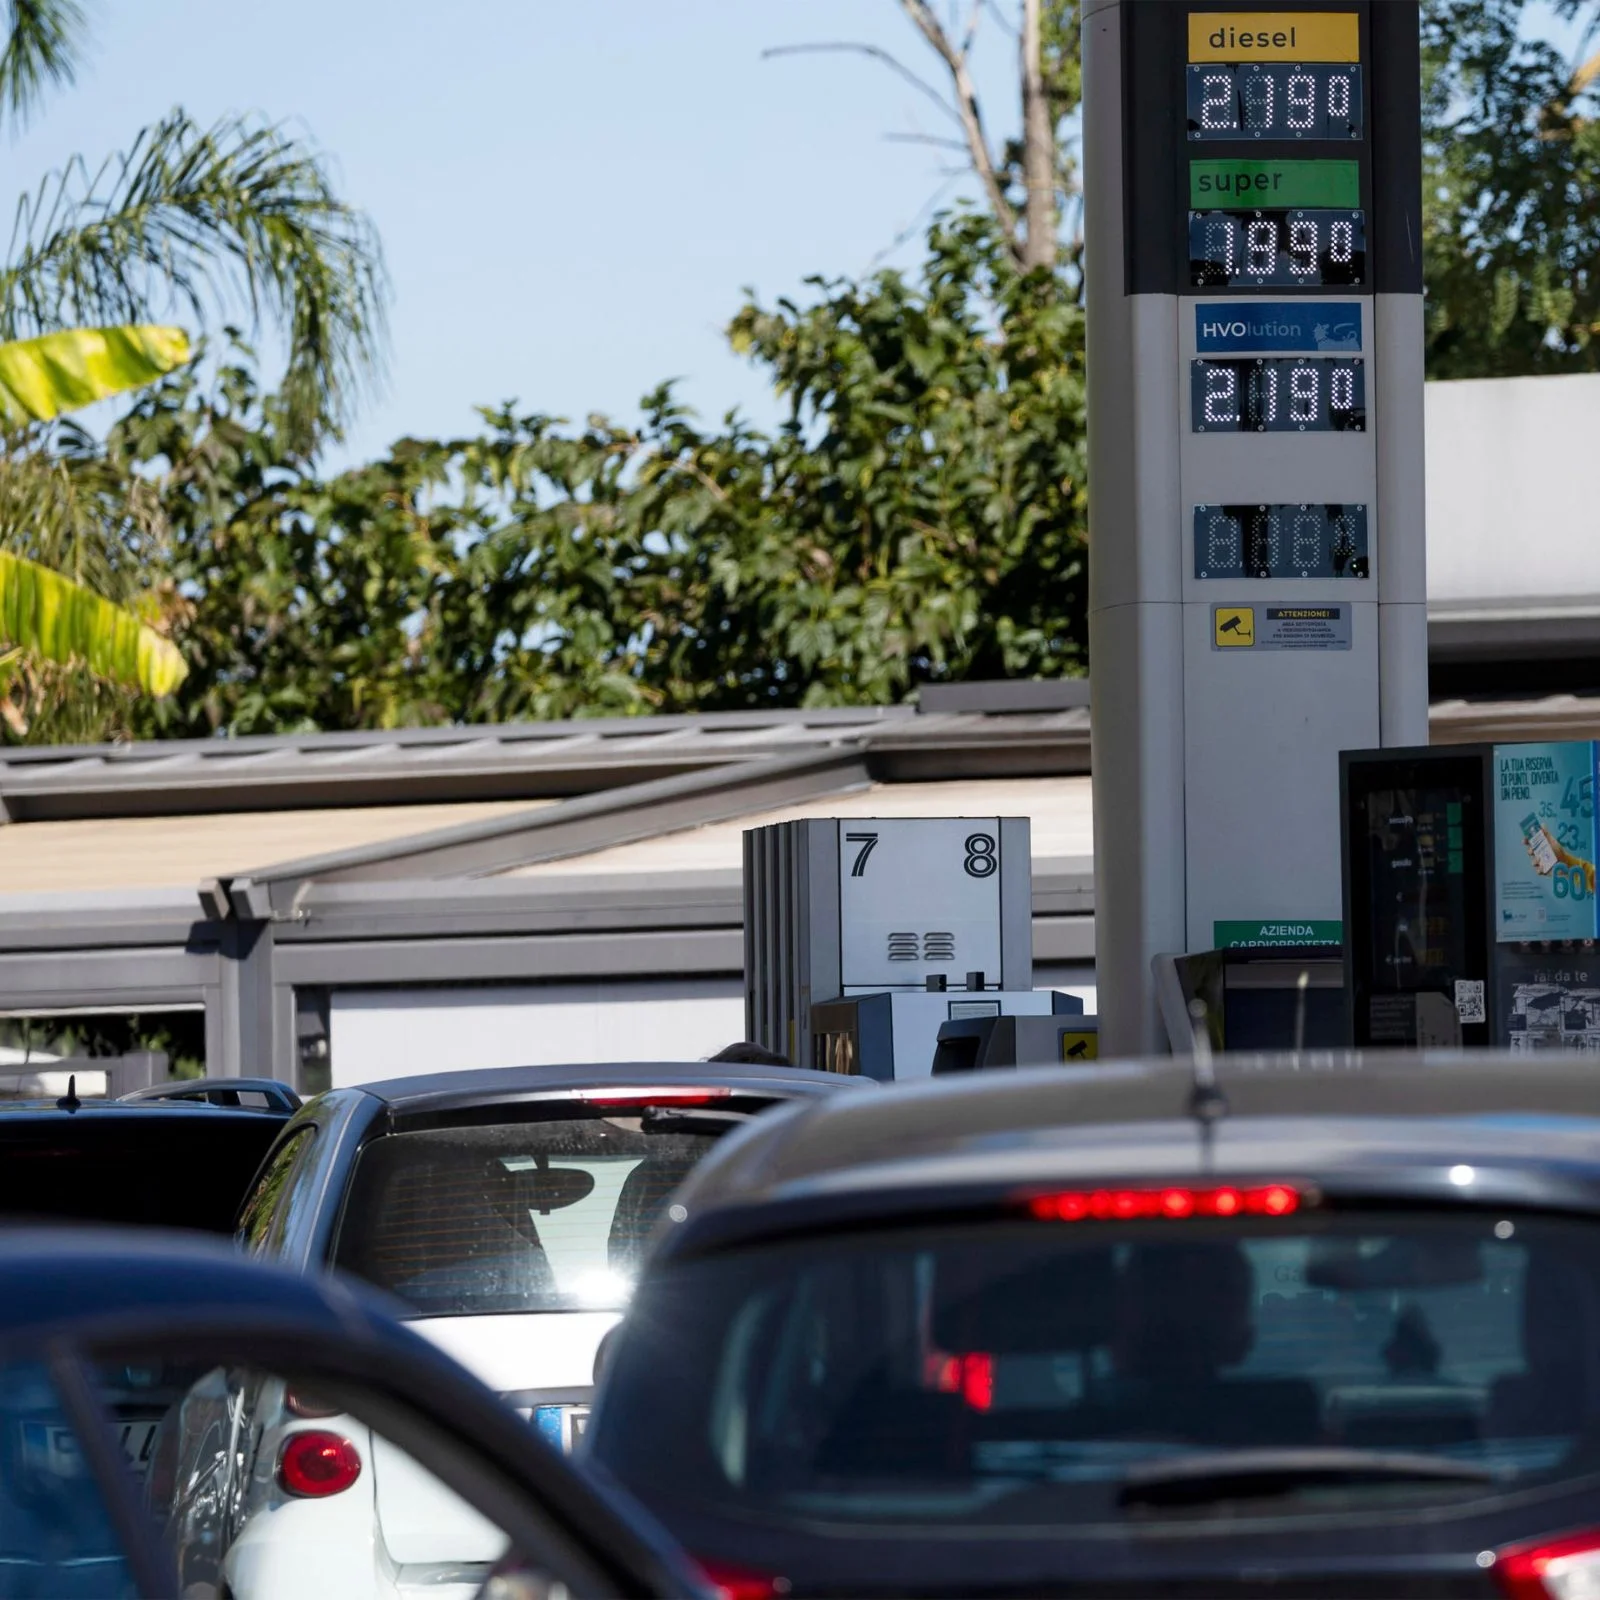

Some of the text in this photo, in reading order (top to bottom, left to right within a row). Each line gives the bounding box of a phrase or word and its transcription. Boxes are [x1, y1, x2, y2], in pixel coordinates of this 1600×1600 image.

[1209, 27, 1296, 48] diesel
[1198, 172, 1282, 197] super
[1202, 321, 1302, 338] HVOlution
[1500, 756, 1554, 772] LA TUA RISERVA
[1531, 770, 1559, 785] DIVENTA
[1557, 821, 1579, 851] 23
[845, 832, 879, 877] 7
[963, 832, 998, 879] 8
[1552, 862, 1586, 901] 60
[1259, 925, 1314, 936] AZIENDA
